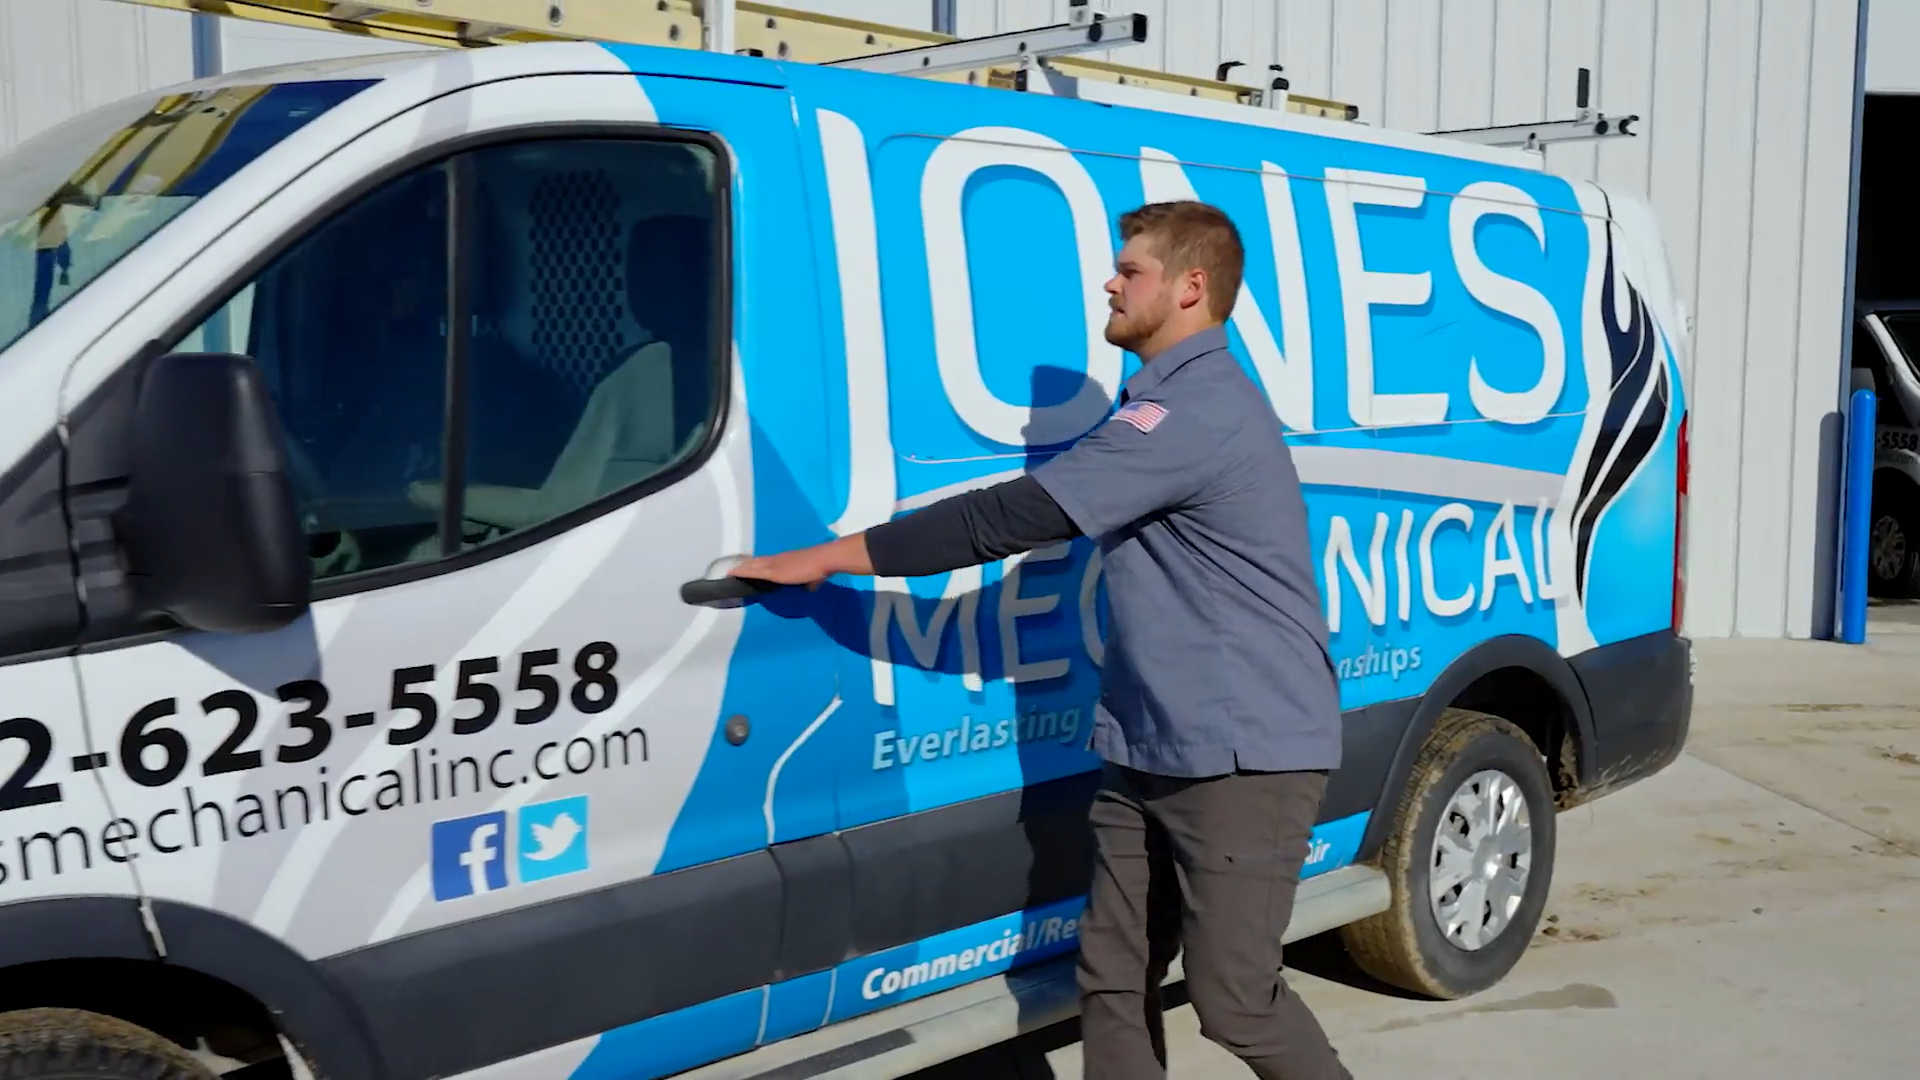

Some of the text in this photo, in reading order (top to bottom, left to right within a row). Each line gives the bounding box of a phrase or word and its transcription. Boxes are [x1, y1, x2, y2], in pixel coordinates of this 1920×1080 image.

[816, 108, 1566, 540] JONES
[869, 497, 1570, 706] MENICAL
[872, 706, 1081, 770] Everlasting
[862, 916, 1081, 1000] Commercial/Re
